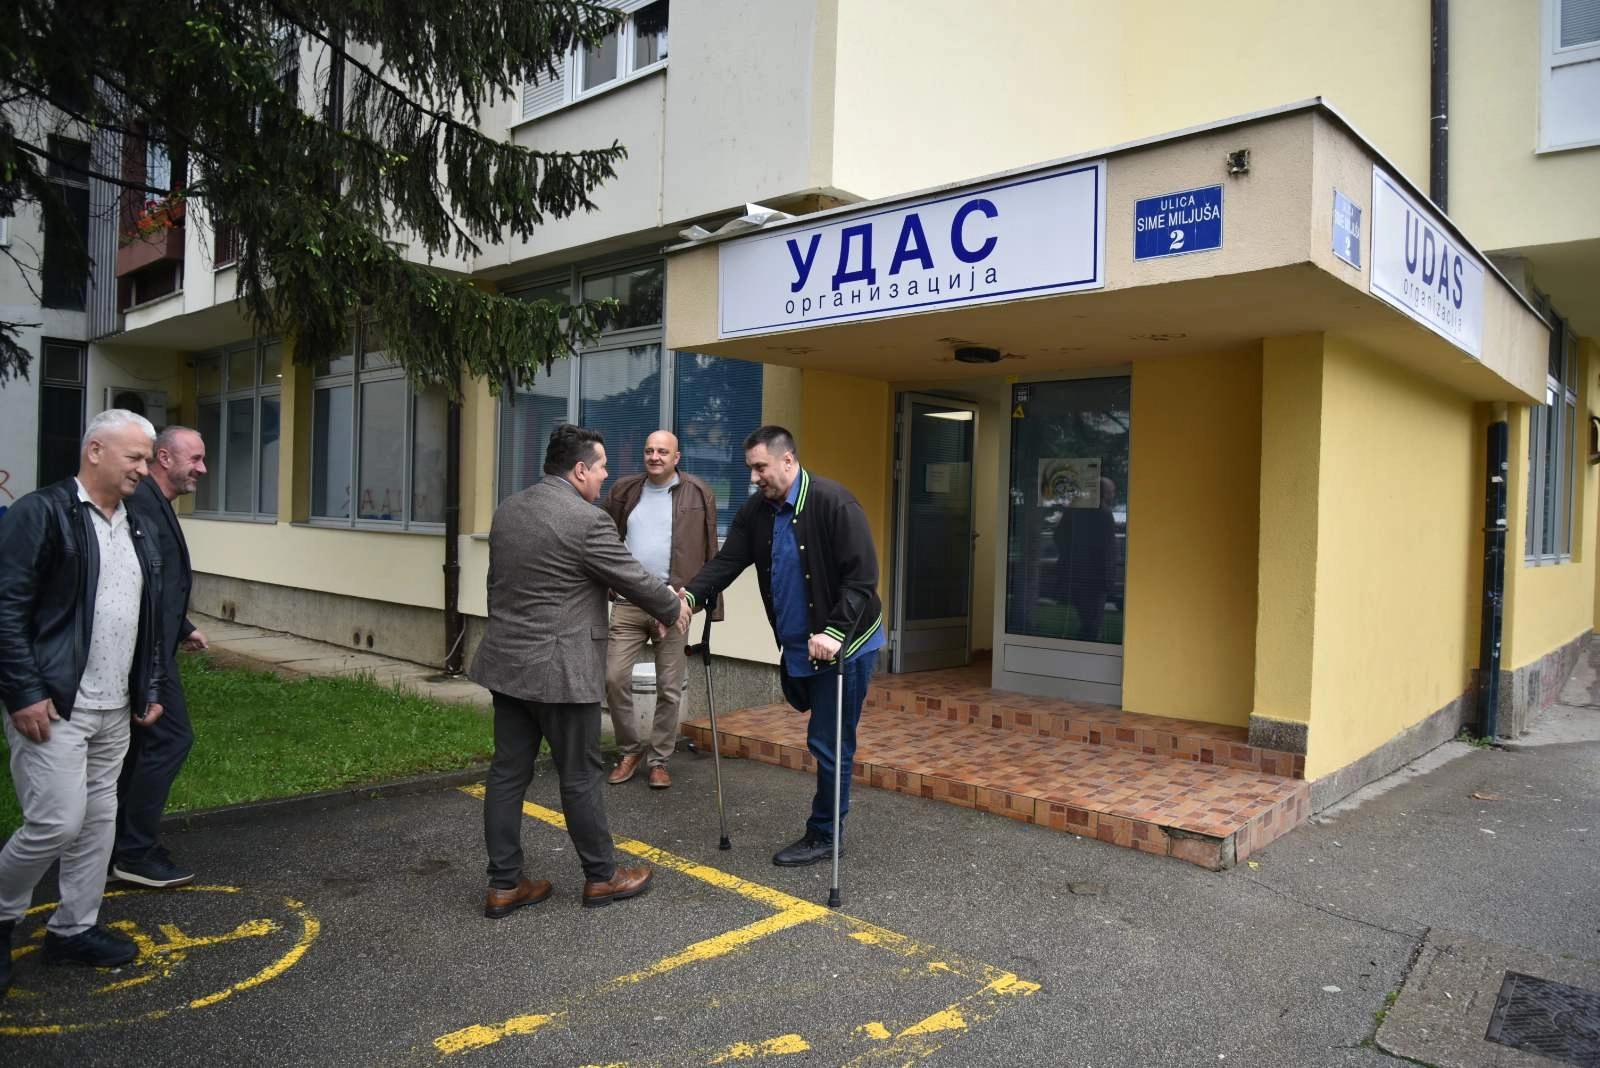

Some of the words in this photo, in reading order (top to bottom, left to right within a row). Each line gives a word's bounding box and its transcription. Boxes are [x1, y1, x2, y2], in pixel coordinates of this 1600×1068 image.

[1137, 213, 1165, 232] SIME
[1168, 203, 1220, 226] MILJUŠA
[1160, 195, 1195, 211] ULICA
[786, 199, 998, 293] УДАС
[1169, 229, 1185, 250] 2
[1404, 209, 1463, 310] UDAS
[785, 265, 997, 316] организација
[1402, 277, 1463, 333] organizacija
